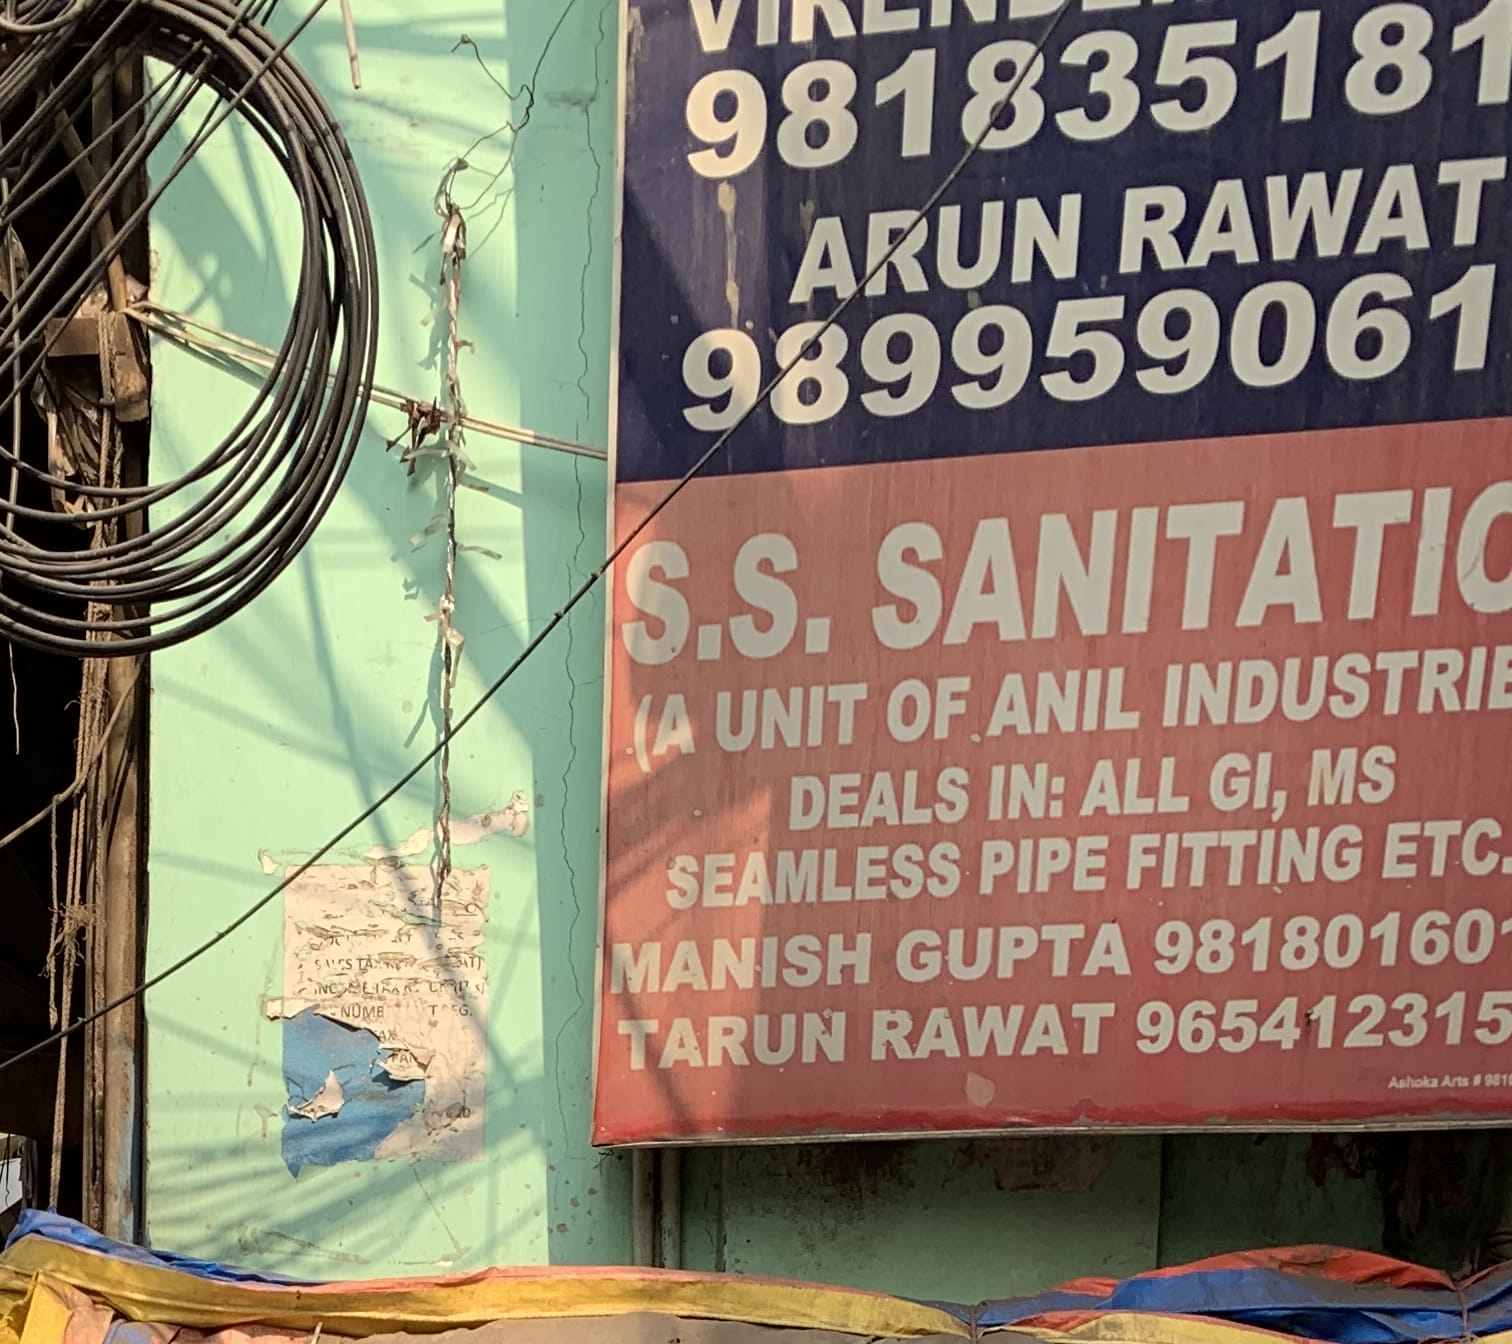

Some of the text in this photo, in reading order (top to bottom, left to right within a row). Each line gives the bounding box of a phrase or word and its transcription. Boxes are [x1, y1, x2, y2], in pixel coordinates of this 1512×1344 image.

[686, 1, 1512, 179] 981835181
[789, 157, 1507, 304] ARUN RAWAT
[682, 263, 1496, 432] 989959061
[621, 481, 1512, 666] S.S. SANITATIO
[634, 693, 696, 773] (A
[716, 683, 868, 753] UNIT
[888, 676, 972, 743] OF
[987, 666, 1140, 737] ANIL
[789, 744, 1397, 831] DEALS IN: ALL GI, MS
[665, 817, 1512, 911] SEAMLESS PIPE FITTING ETC.
[610, 932, 872, 994] MANISH
[895, 922, 1132, 983] GUPTA
[618, 990, 1512, 1070] TARUN RAWAT 965412315
[1388, 1075, 1438, 1089] Ashoka
[1441, 1074, 1469, 1088] Arts
